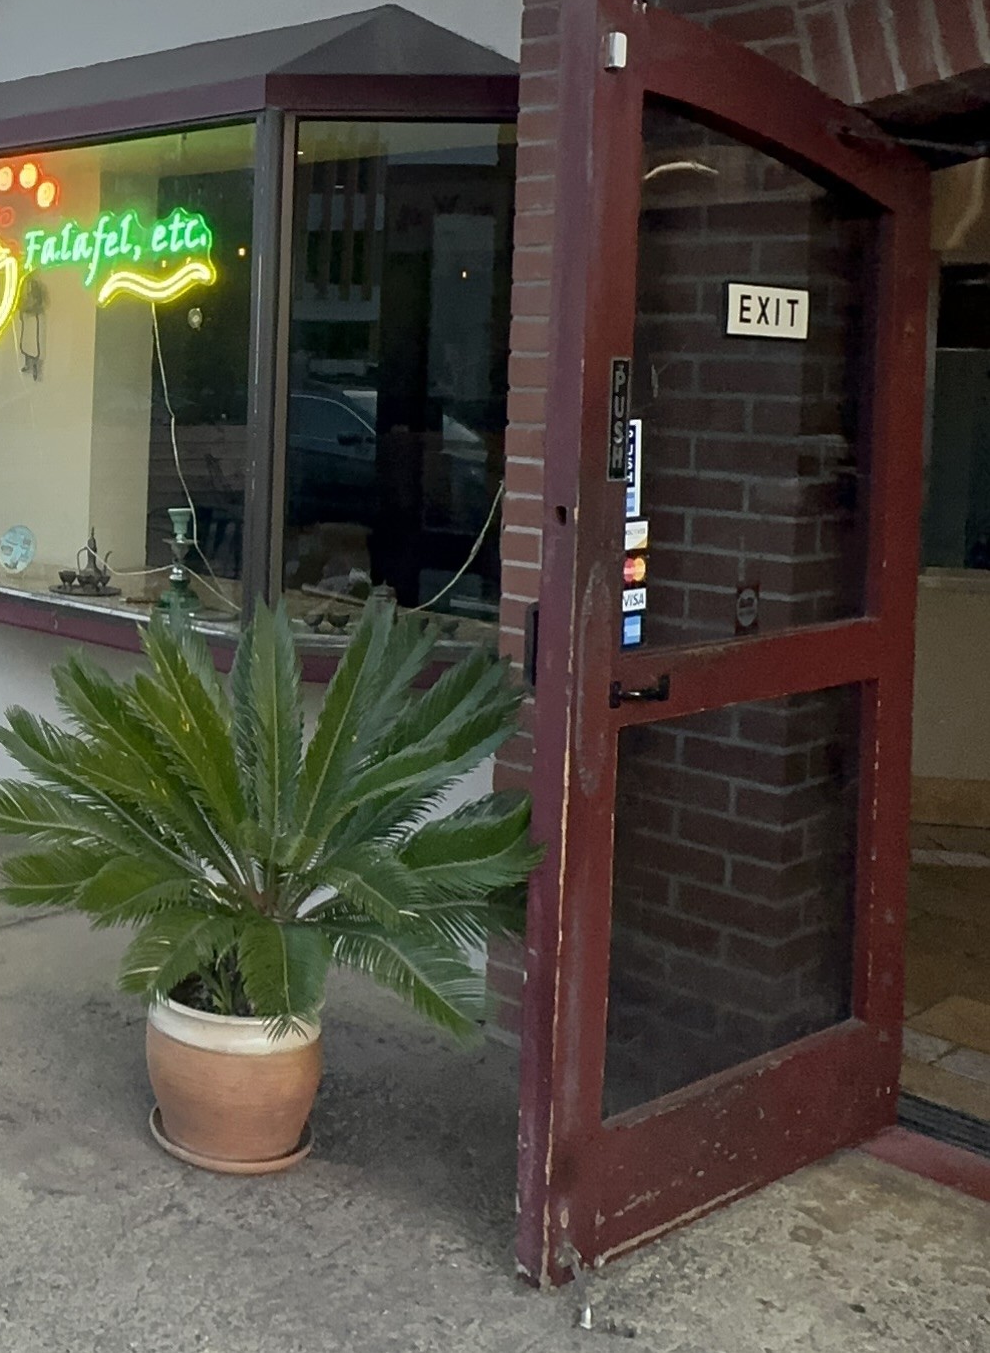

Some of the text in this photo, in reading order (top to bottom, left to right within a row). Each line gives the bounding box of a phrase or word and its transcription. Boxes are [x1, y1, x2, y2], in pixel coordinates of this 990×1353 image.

[25, 214, 141, 286] Falafel,
[738, 293, 800, 329] EXIT
[612, 370, 627, 468] PUSH
[623, 592, 645, 607] VISA
